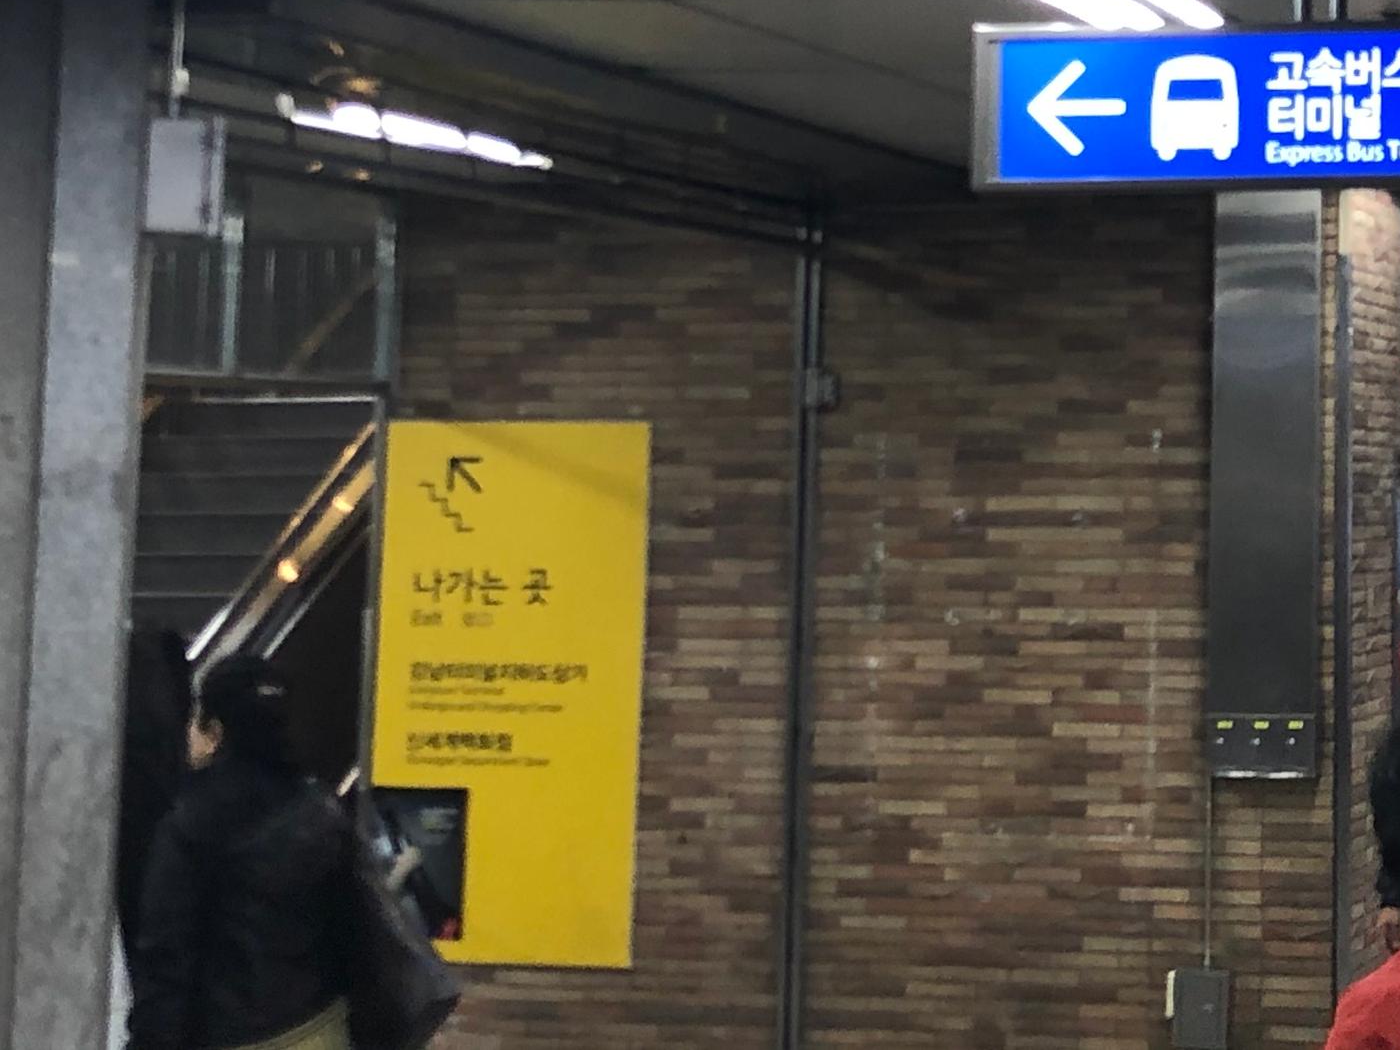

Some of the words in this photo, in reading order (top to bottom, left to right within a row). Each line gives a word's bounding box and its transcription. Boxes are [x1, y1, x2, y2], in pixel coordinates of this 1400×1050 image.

[1267, 92, 1381, 141] 터미널
[1265, 140, 1344, 167] Express
[1346, 140, 1384, 163] Bus
[413, 568, 509, 606] 나가는
[523, 568, 554, 606] 곳
